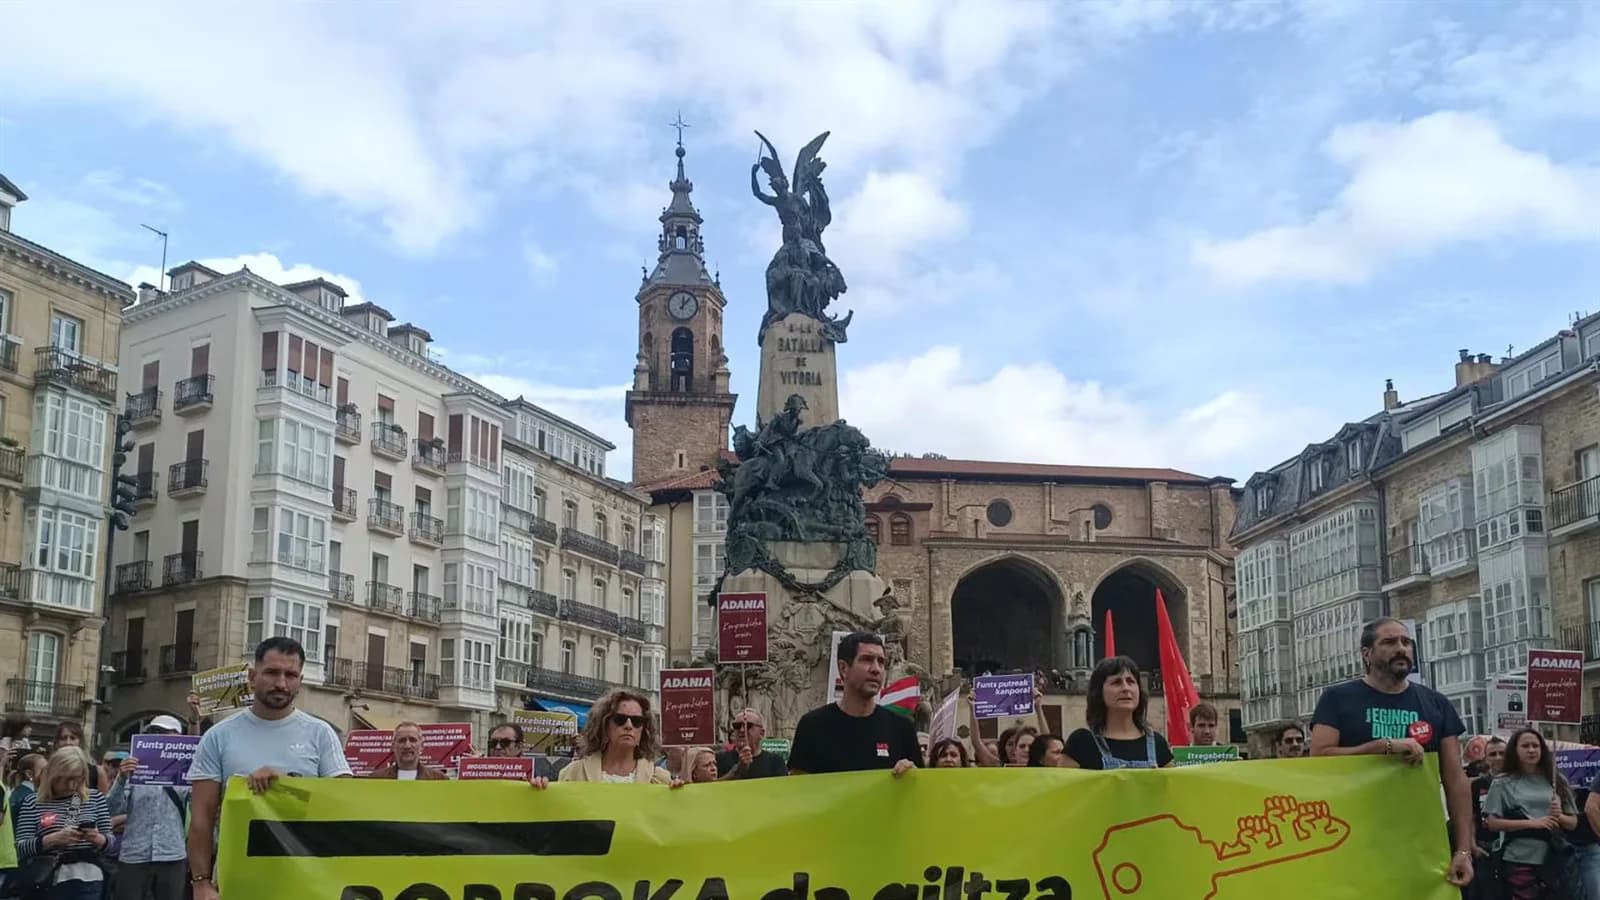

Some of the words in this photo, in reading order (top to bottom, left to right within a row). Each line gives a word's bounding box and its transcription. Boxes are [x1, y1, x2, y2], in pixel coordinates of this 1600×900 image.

[778, 337, 825, 353] BATALLA
[796, 357, 806, 367] DE
[780, 371, 823, 386] VITORIA
[721, 600, 765, 610] ADANIA
[1531, 658, 1581, 669] ADANIA
[663, 678, 712, 689] ADANIA
[998, 679, 1028, 688] putreak
[136, 741, 164, 749] Funts
[164, 741, 198, 751] putrea
[160, 750, 194, 760] kanpo
